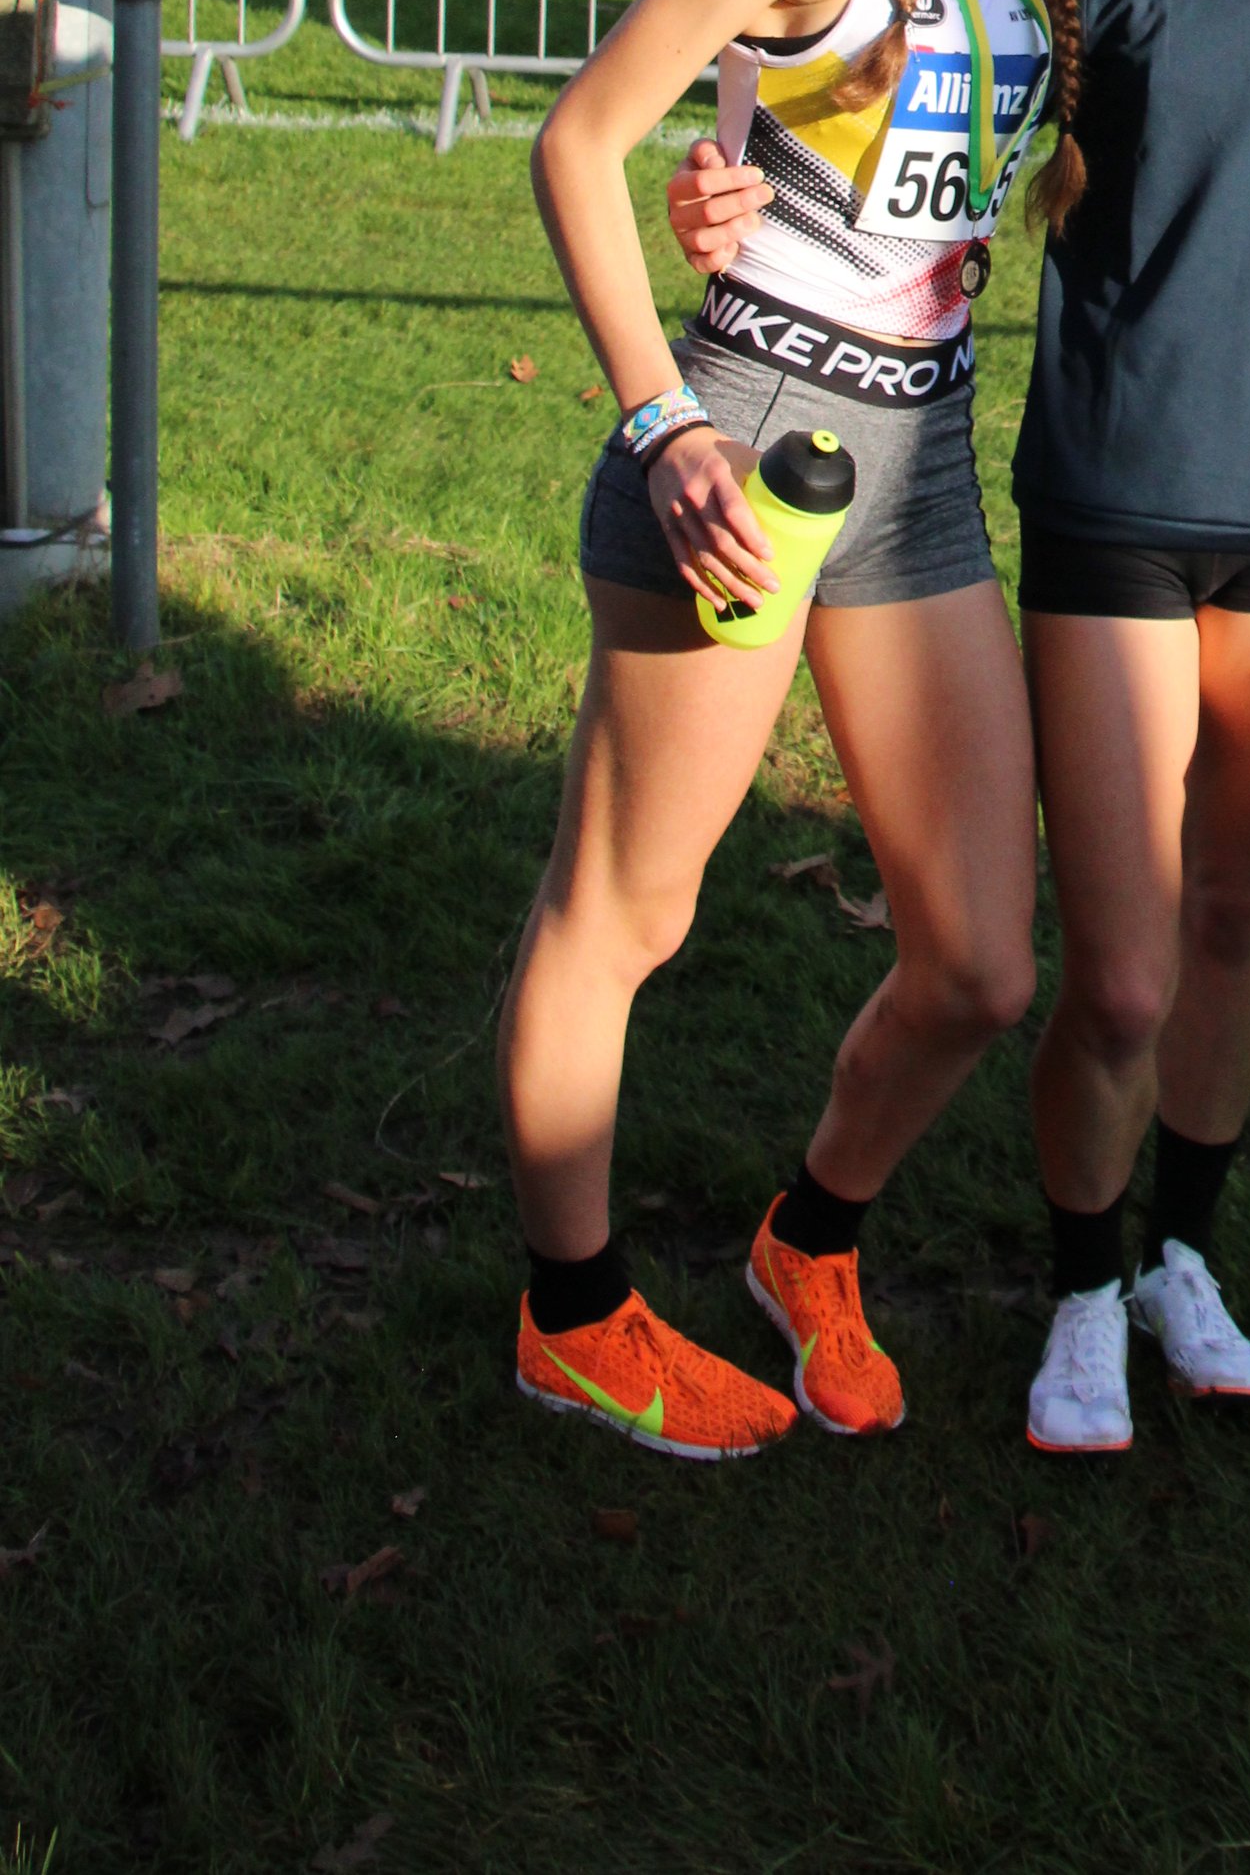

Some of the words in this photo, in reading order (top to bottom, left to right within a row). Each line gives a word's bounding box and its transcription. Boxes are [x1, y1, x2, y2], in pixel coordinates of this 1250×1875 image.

[911, 10, 942, 22] ermarc
[906, 69, 1029, 115] Allinz
[701, 284, 830, 368] NIKE
[819, 340, 940, 397] PRO
